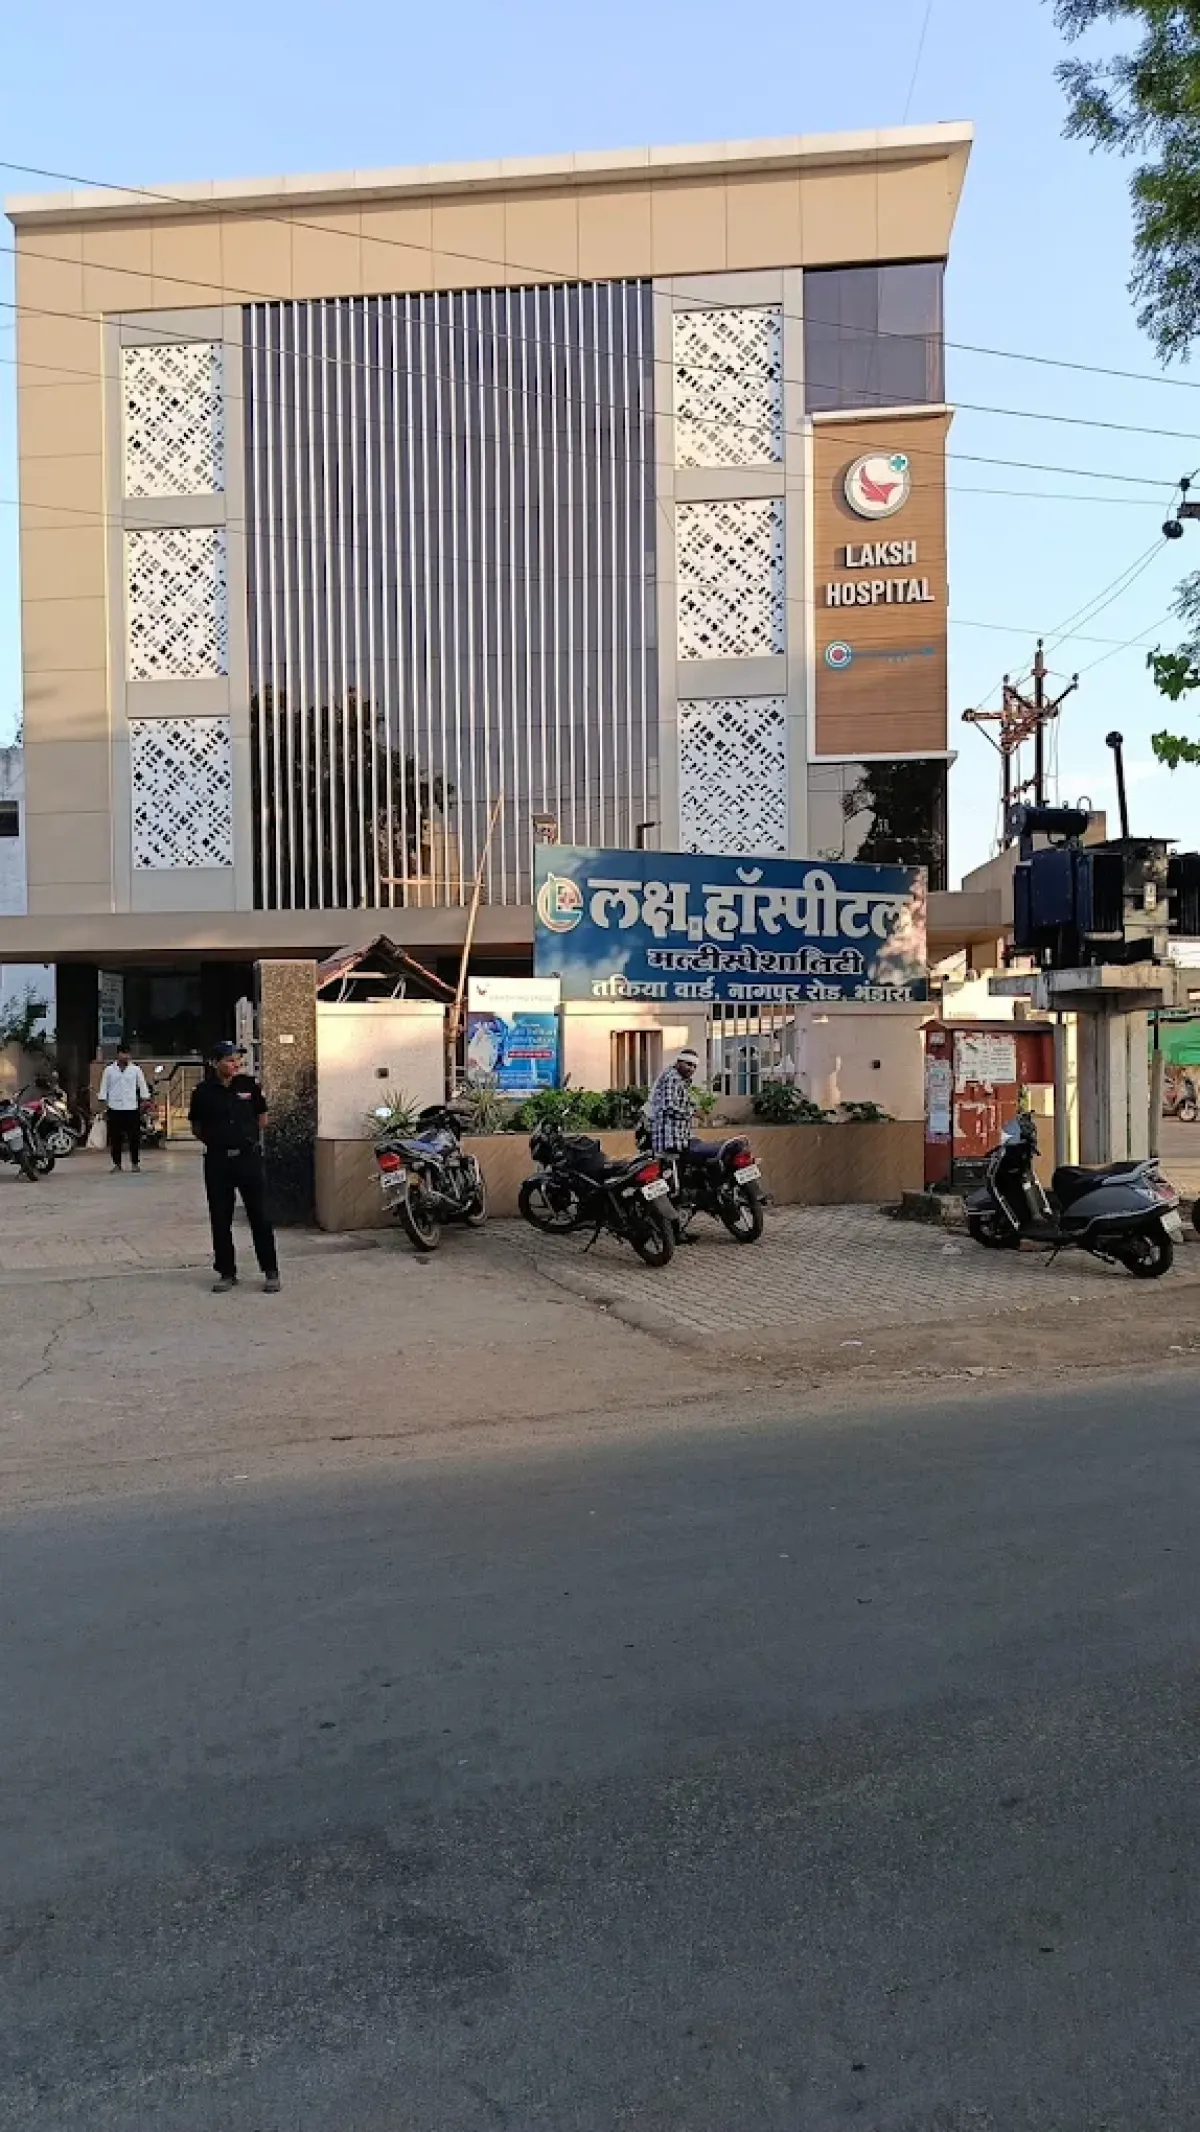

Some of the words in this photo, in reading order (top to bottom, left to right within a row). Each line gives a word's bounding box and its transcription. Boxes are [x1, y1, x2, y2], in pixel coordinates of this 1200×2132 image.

[845, 540, 917, 568] LAKSH
[826, 577, 936, 607] HOSPITAL
[591, 973, 668, 997] तकिया
[727, 983, 801, 1002] नागपुर
